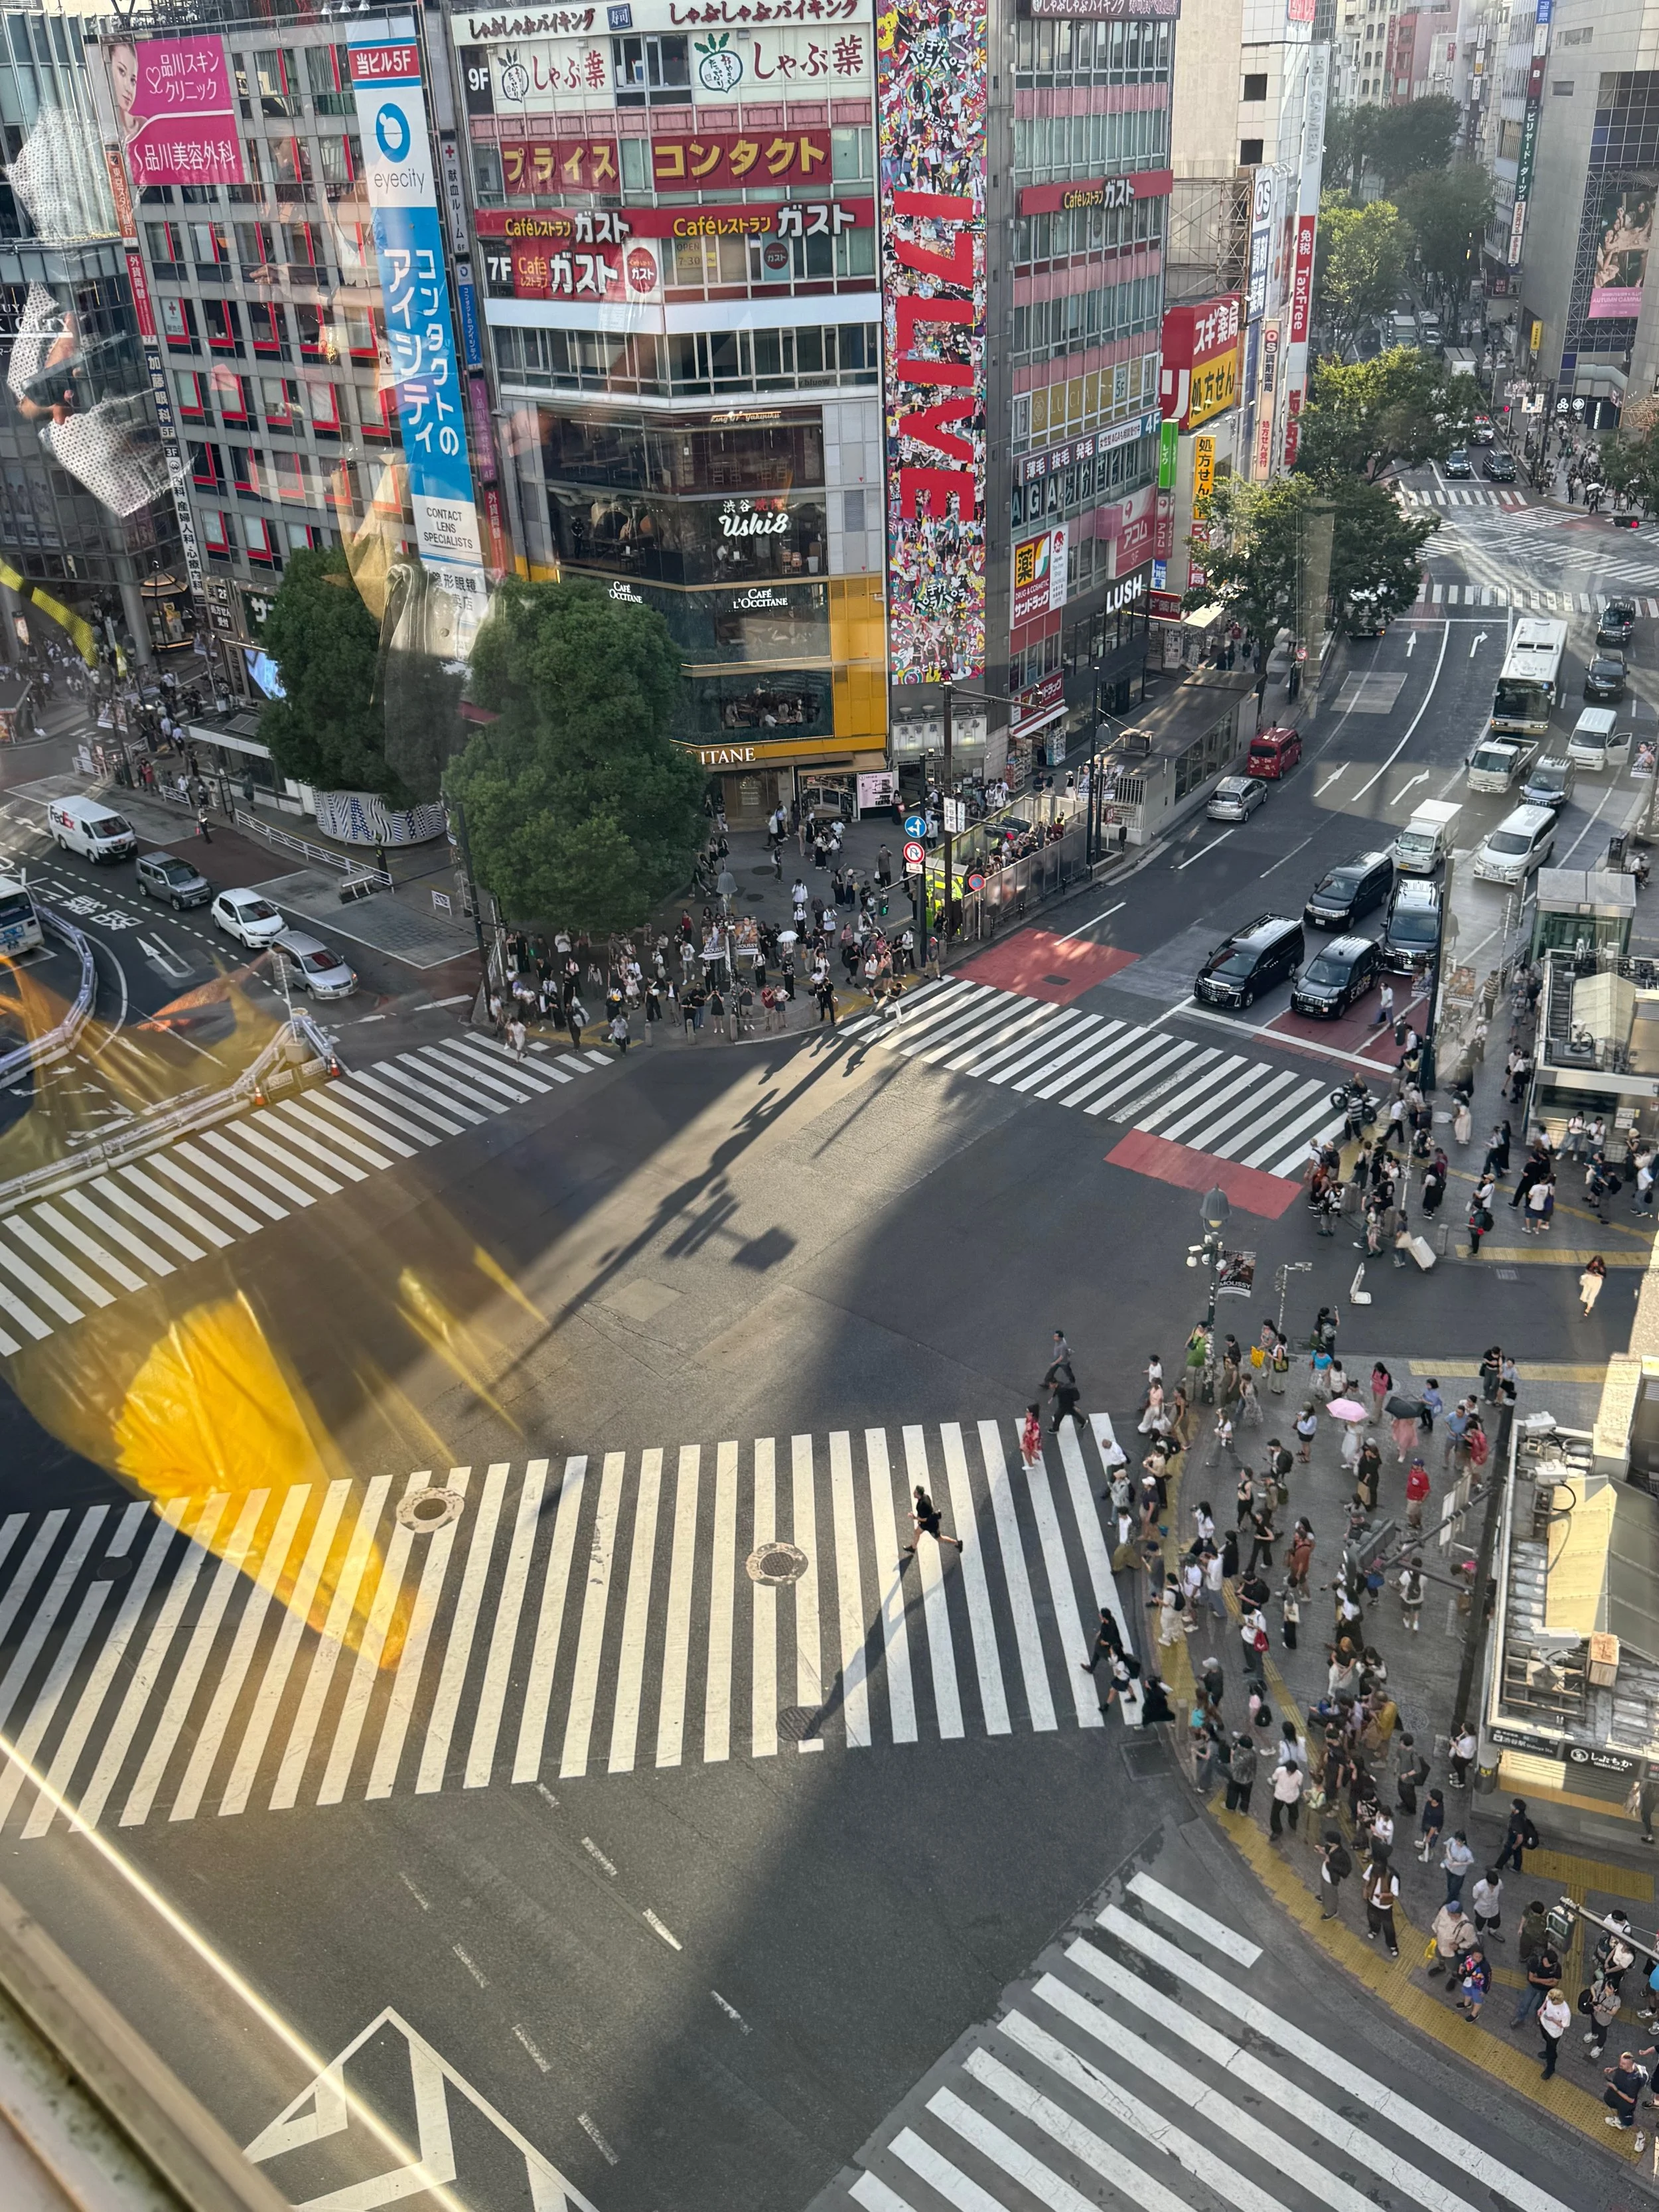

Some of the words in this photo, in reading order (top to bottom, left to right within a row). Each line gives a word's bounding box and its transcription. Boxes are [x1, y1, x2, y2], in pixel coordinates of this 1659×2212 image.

[469, 8, 596, 39] しゃぶしゃぶバイキング
[611, 9, 629, 24] 寿司
[670, 0, 858, 25] しゃぶしゃぶバイキング
[161, 50, 219, 78] 品川スキン
[356, 50, 411, 75] 当ビル5F
[533, 50, 605, 90] しゃぶ葉
[754, 34, 863, 80] しゃぶ葉
[165, 78, 217, 102] クリニック
[469, 68, 488, 91] 9F
[145, 140, 236, 171] 品川美容外科
[504, 145, 616, 182] プライス
[654, 137, 826, 178] コンタクト
[1518, 112, 1534, 193] ビリヤード・ダーツ
[374, 168, 425, 194] eyecity
[1104, 179, 1135, 209] ガスト
[447, 169, 465, 240] 献血ルーム
[1256, 180, 1271, 216] OS
[505, 218, 571, 237] Caféレストラン
[574, 210, 630, 244] ガスト
[673, 216, 771, 237] Caféレストラン
[777, 204, 855, 238] ガスト
[457, 243, 466, 252] 6F
[766, 254, 786, 263] ガスト
[487, 256, 511, 281] 7F
[518, 257, 547, 276] Café
[550, 251, 618, 293] ガスト
[632, 267, 655, 280] ガスト
[1293, 266, 1310, 330] TaxFree
[144, 335, 155, 344] 7F
[1194, 305, 1239, 356] スギ薬局
[1265, 331, 1278, 354] OS
[384, 248, 433, 453] アイシティ
[415, 249, 459, 456] コンタクトの
[147, 355, 171, 423] 加藤眼科
[1116, 382, 1125, 398] 5F
[1190, 361, 1235, 418] 処方せん
[161, 427, 174, 437] 5F
[1145, 411, 1161, 434] 4F
[164, 447, 178, 457] 3F
[1076, 438, 1094, 461] 発毛
[483, 469, 494, 480] 4F
[1012, 478, 1057, 520] AGA
[427, 506, 463, 522] CONTACT
[436, 521, 457, 534] LENS
[718, 511, 790, 538] Ushi8
[176, 501, 195, 545] 産婦人科
[186, 546, 203, 592] 心療内科
[423, 532, 474, 550] SPECIALISTS
[1123, 520, 1147, 550] アコム
[1157, 522, 1166, 548] アコム
[1017, 548, 1033, 585] 薬
[1015, 589, 1050, 619] サンドラッグ
[1106, 573, 1143, 615] LUSH
[50, 804, 74, 830] FedEx
[1219, 1280, 1251, 1289] MOUSSY
